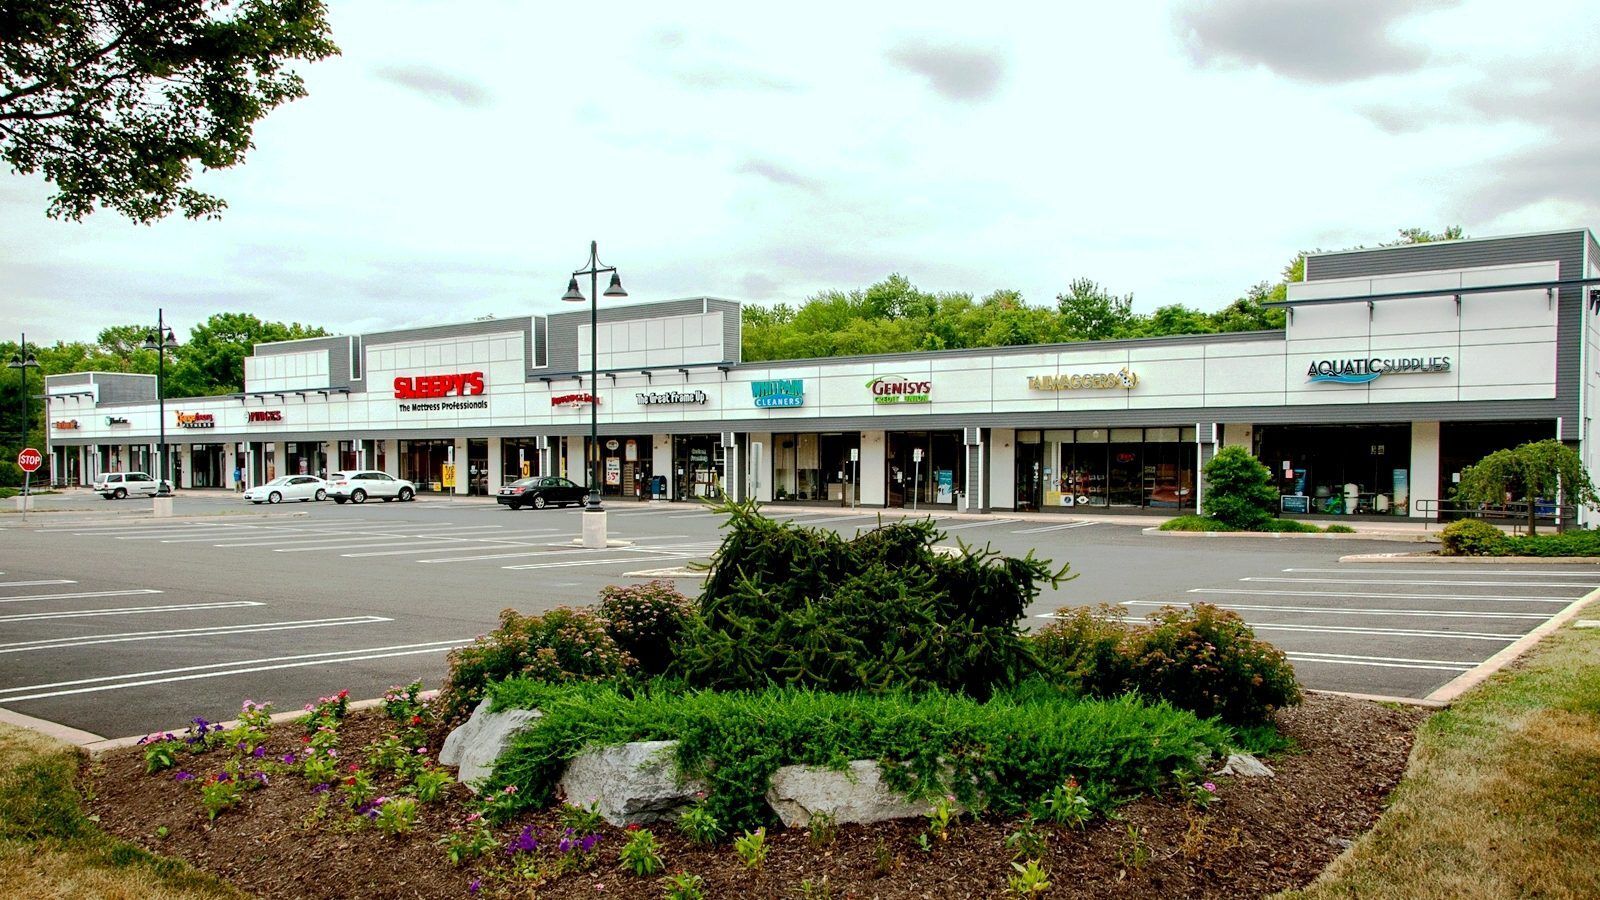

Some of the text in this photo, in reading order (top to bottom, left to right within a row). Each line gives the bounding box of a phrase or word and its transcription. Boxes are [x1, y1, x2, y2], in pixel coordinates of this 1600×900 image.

[1307, 356, 1450, 377] AQUATIC SUPPLIES
[394, 371, 484, 399] SLEEPY'S
[636, 393, 648, 405] The
[649, 392, 670, 405] Great
[695, 390, 706, 405] Up
[756, 398, 801, 406] CLEANERS
[399, 400, 488, 412] The Mattress Professionals
[20, 455, 41, 464] STOP
